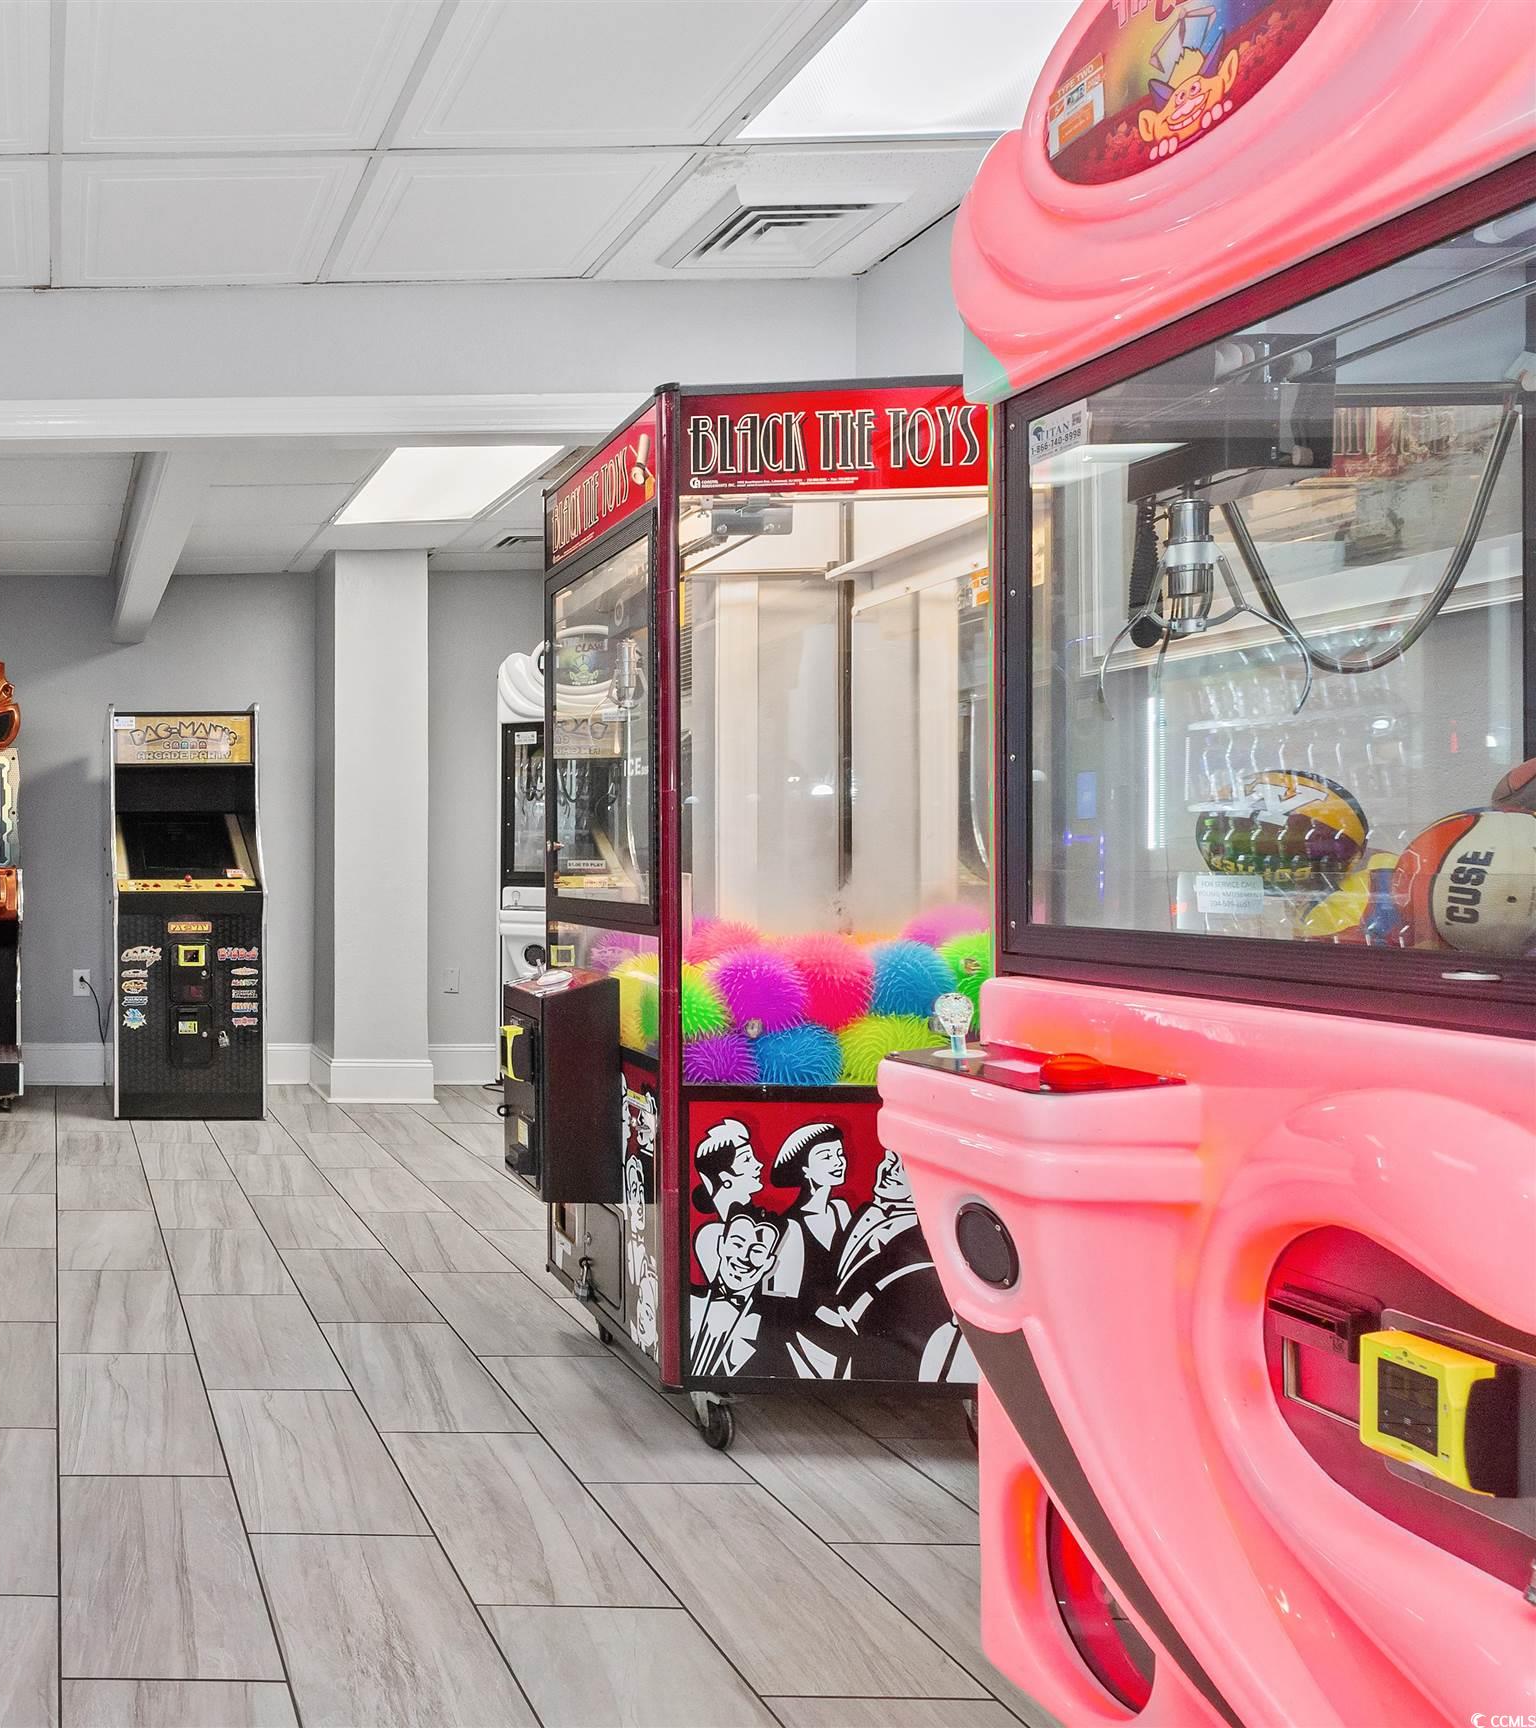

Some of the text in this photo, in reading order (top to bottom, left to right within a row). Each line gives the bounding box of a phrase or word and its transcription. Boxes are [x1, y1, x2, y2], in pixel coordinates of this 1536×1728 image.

[688, 405, 980, 475] BLACK TIE TOYS
[552, 446, 629, 554] BLACK TIE TOYS
[136, 751, 189, 760] ARCADE
[170, 923, 209, 931] PAC-MAN
